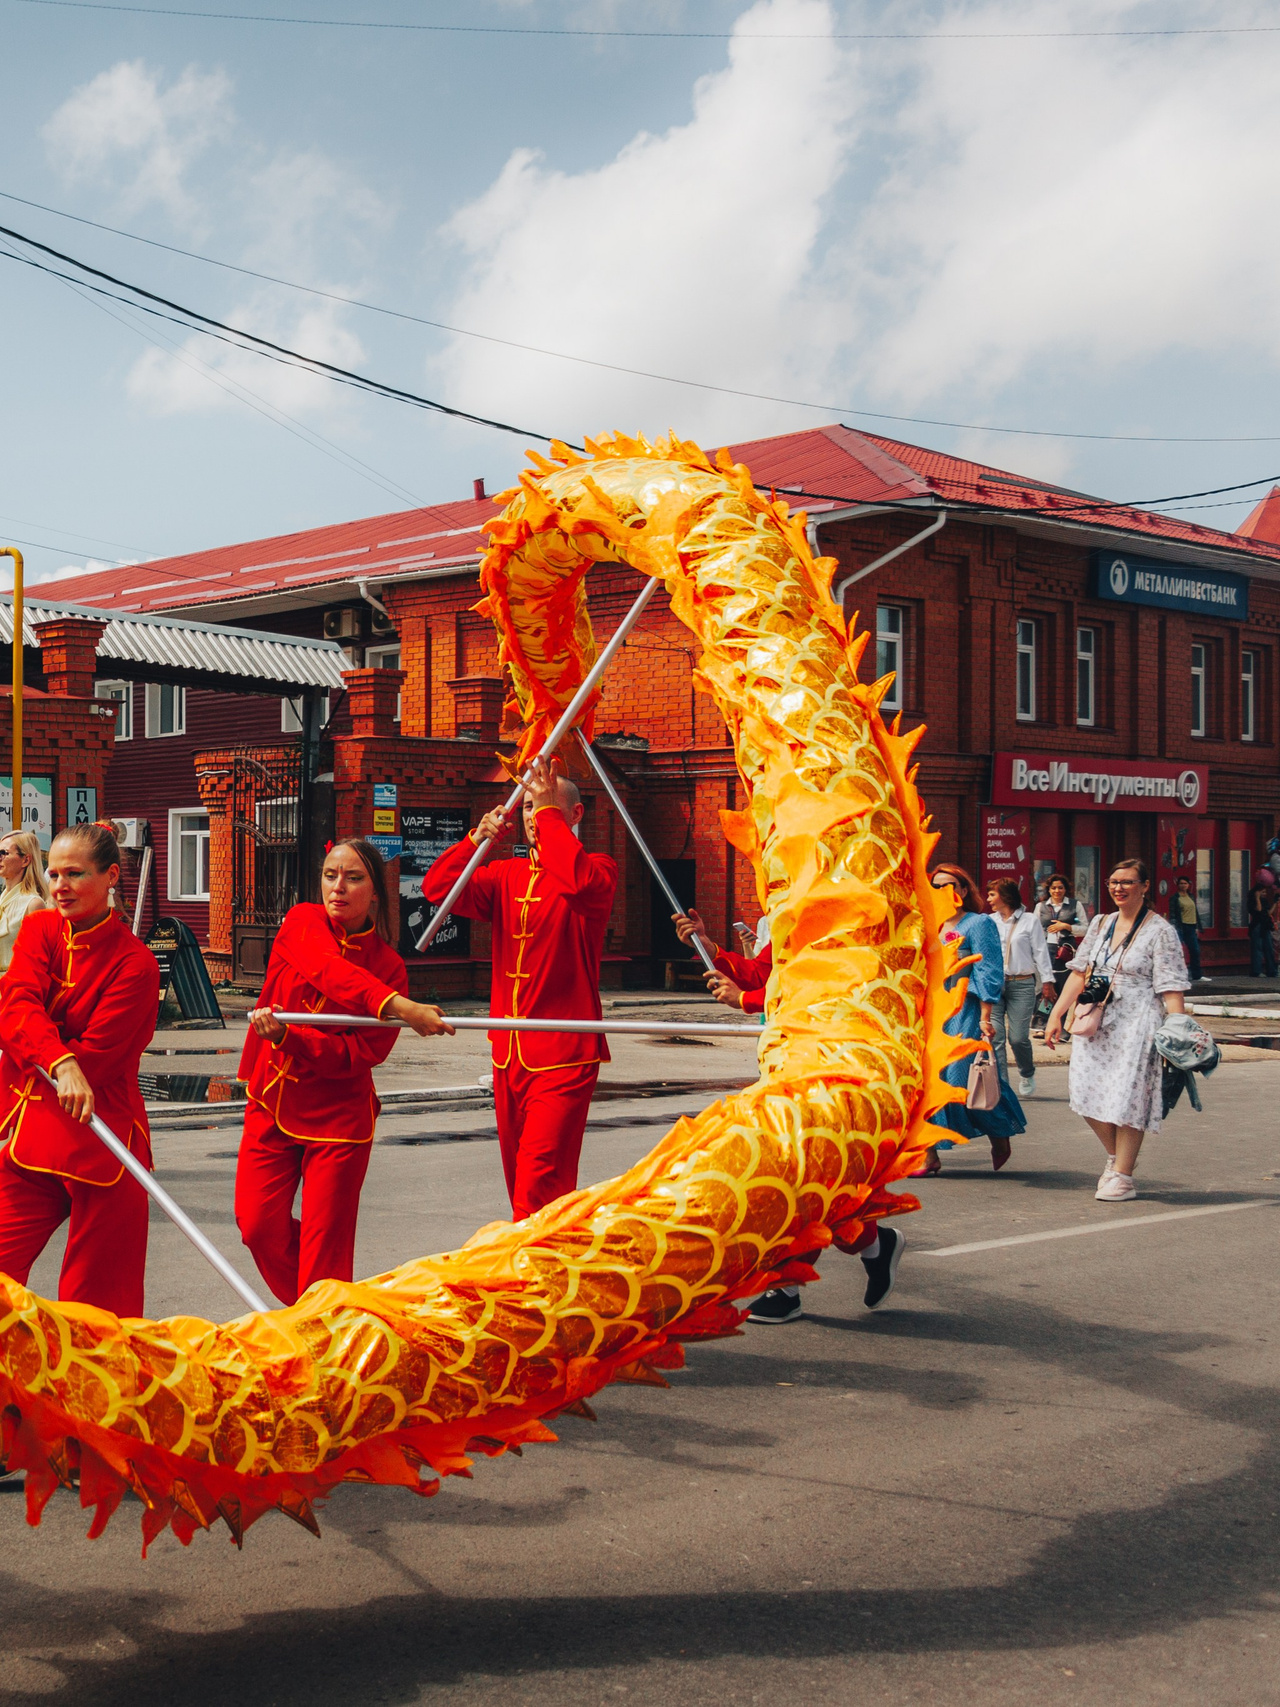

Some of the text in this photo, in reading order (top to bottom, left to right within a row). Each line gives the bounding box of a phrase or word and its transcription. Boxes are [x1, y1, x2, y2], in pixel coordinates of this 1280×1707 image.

[1134, 570, 1237, 606] МЕТАЛЛИНВЕСТБАНК
[401, 816, 431, 827] VAPE
[987, 828, 1016, 836] ДЛЯ ДОМА,
[378, 846, 389, 855] 22
[987, 850, 1011, 859] СТРОЙКИ
